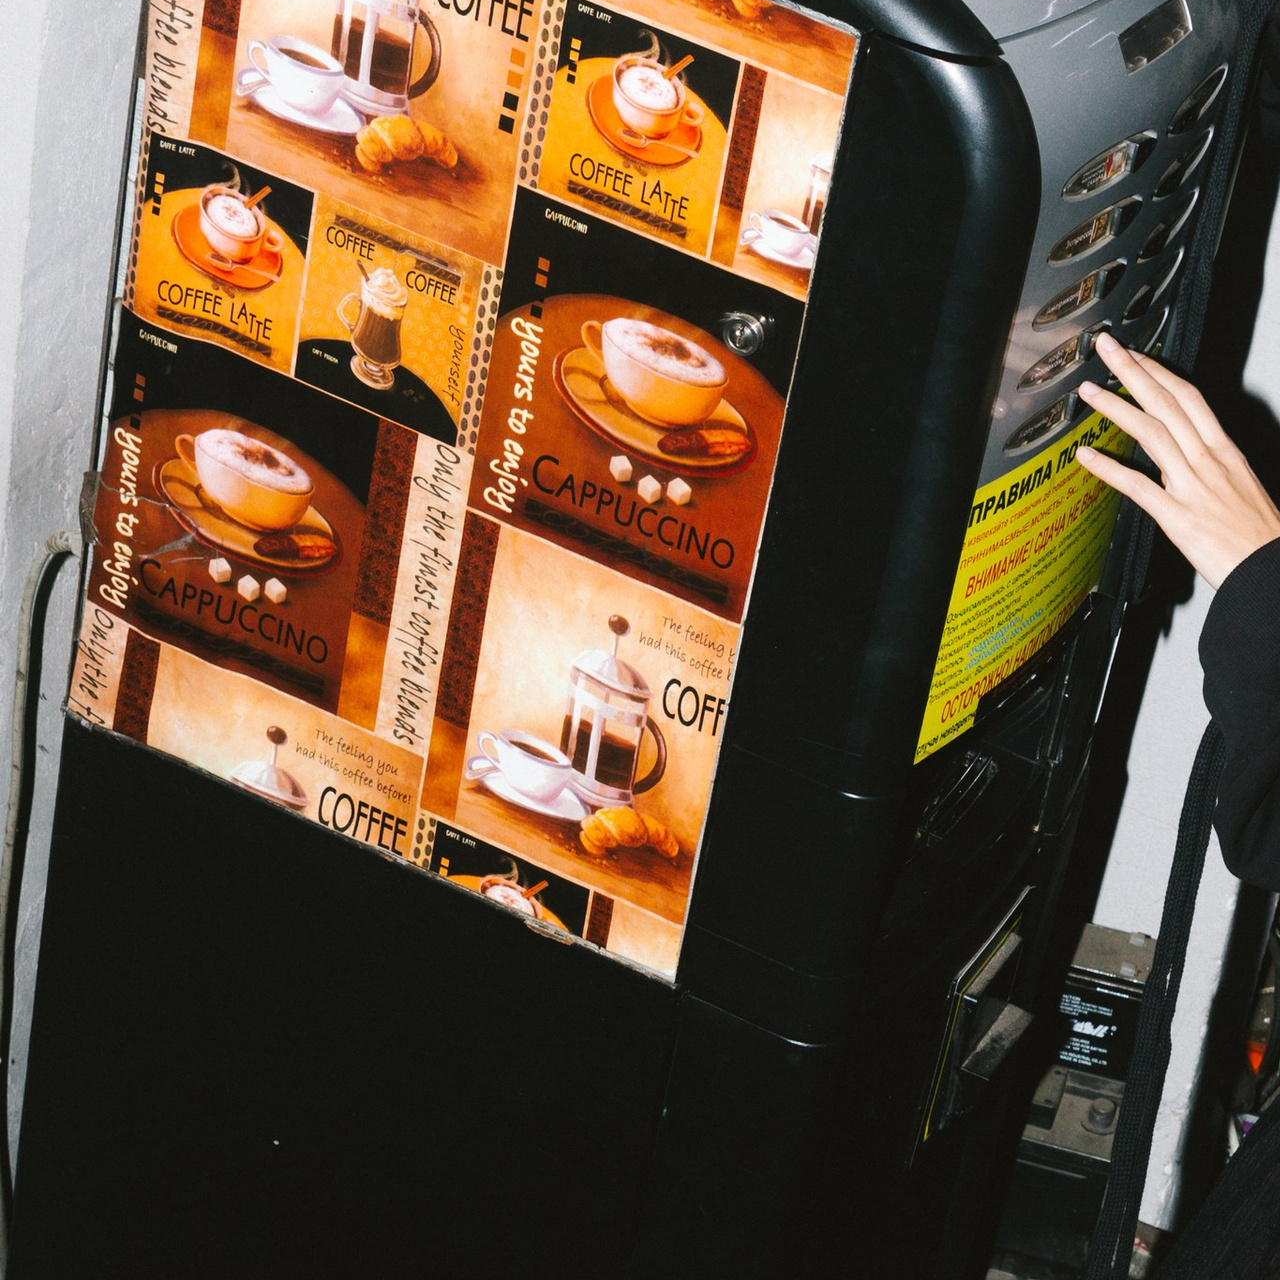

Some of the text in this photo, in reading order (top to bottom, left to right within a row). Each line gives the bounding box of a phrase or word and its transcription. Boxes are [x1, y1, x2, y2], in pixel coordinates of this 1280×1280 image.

[147, 51, 186, 133] blends
[569, 152, 689, 222] COFFEE LATTE
[326, 225, 376, 261] COFFEE
[157, 279, 273, 341] COFFEE LATTE
[405, 270, 457, 306] COFFEE
[442, 324, 466, 407] yourself
[483, 316, 544, 514] yours to enjoy
[99, 426, 143, 610] yours to enjoy
[532, 455, 735, 569] CAPPUCCINO
[968, 460, 1052, 527] ПРАВИЛА
[960, 522, 1029, 570] ПРИНИМАЕМЫЕ
[965, 541, 1033, 599] ВНИМАНИЕ!
[1034, 513, 1066, 555] СДАЧА
[1067, 499, 1082, 527] НЕ
[139, 558, 329, 665] CAPPUCCINO
[393, 444, 461, 746] Only the finest coffee blends
[639, 631, 661, 651] had
[665, 642, 686, 663] this
[689, 653, 723, 680] coffee
[662, 615, 681, 634] The
[685, 625, 726, 657] feeling
[296, 745, 412, 805] had this coffee before!
[315, 729, 399, 777] The feeling you
[318, 785, 408, 857] COFFEE
